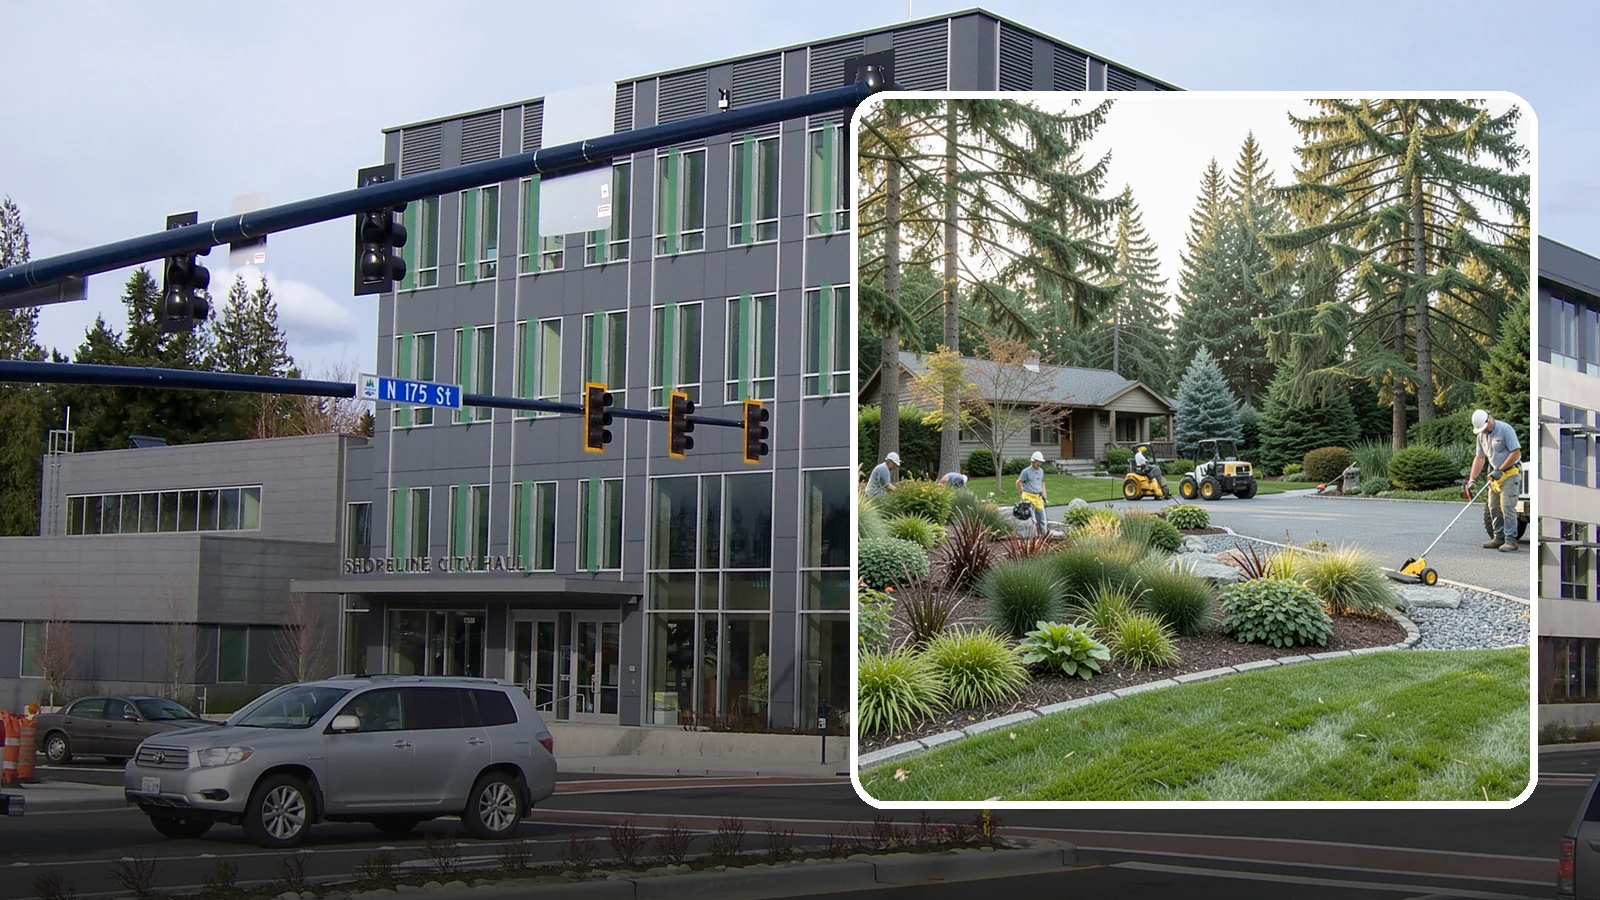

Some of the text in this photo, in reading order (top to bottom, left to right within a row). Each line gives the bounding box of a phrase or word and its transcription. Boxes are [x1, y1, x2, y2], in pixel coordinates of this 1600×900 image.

[387, 380, 451, 406] N 175 St
[344, 555, 525, 574] SHORELINE CITY HALL
